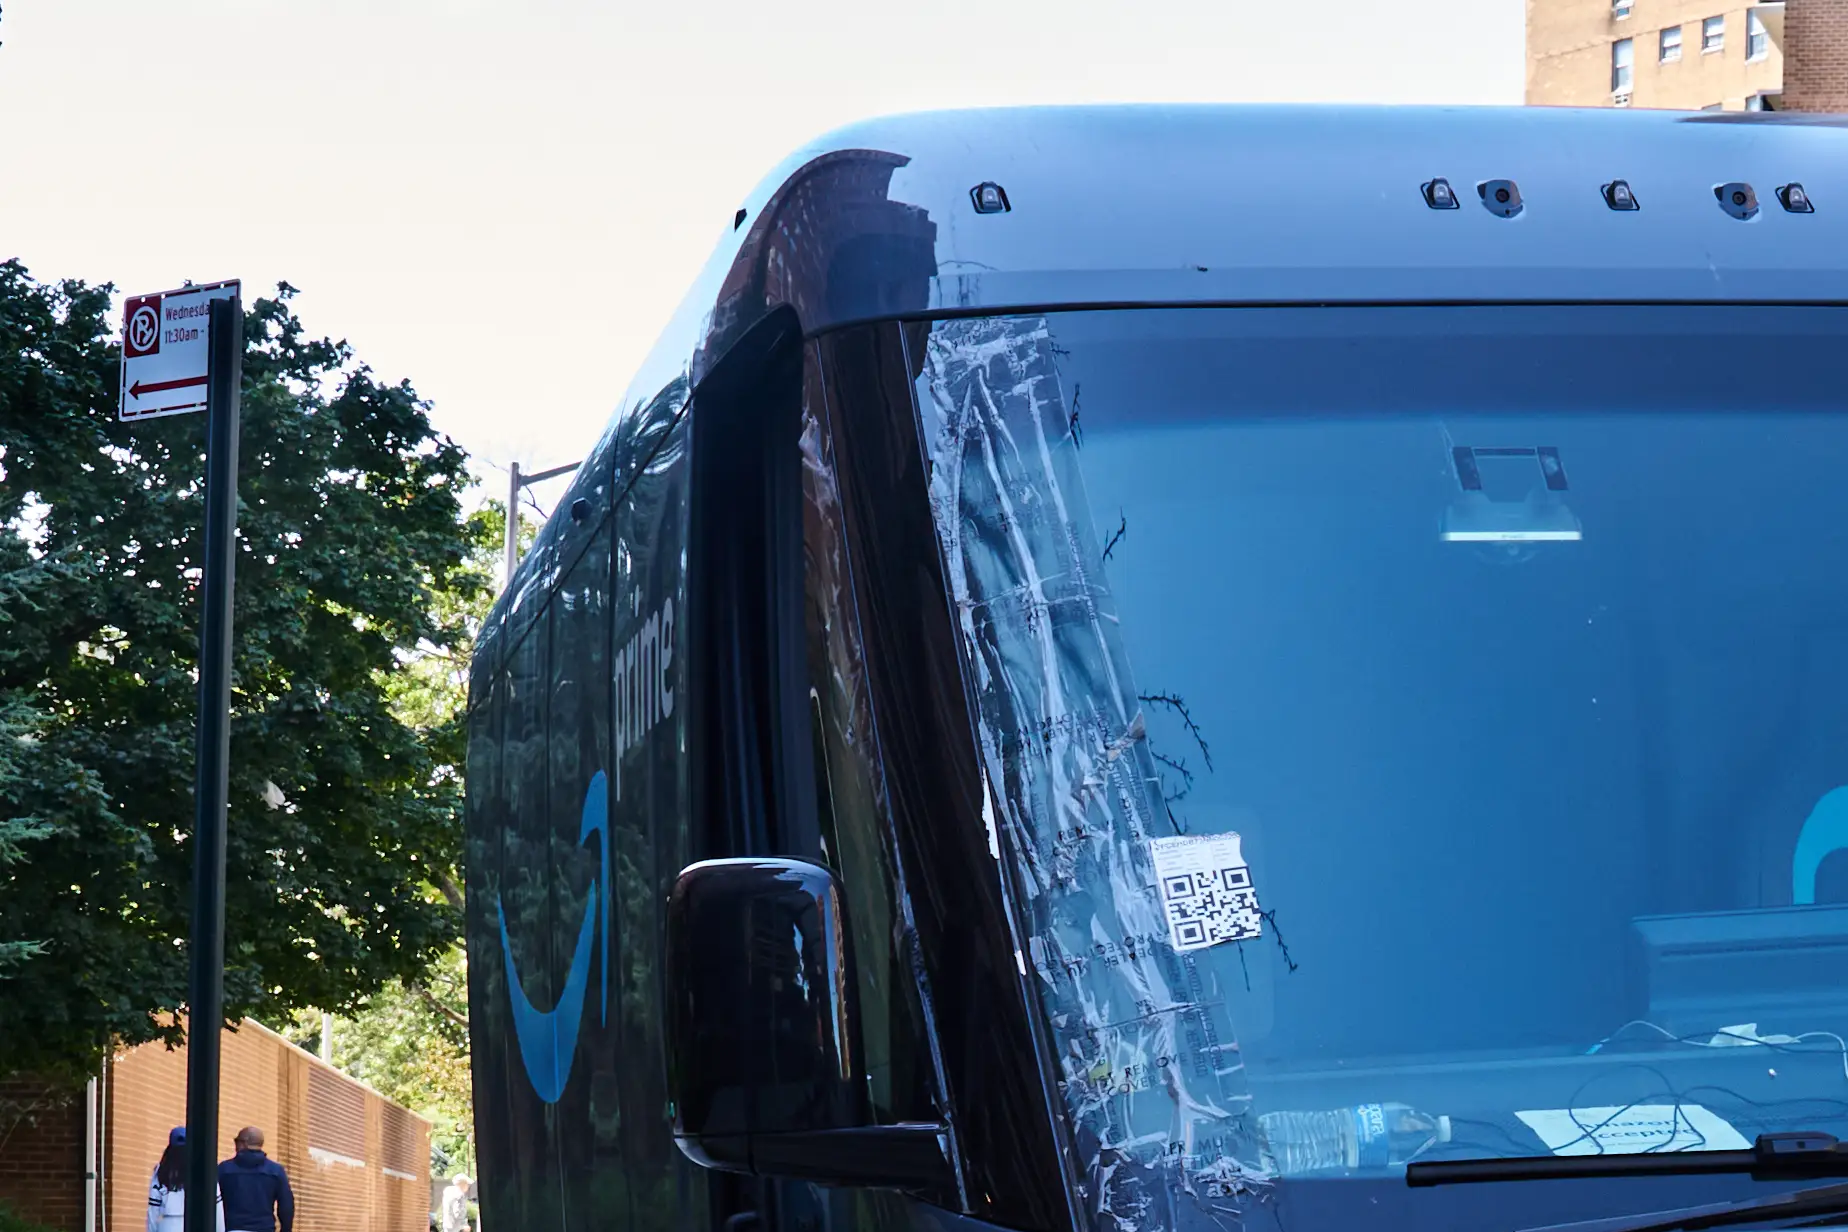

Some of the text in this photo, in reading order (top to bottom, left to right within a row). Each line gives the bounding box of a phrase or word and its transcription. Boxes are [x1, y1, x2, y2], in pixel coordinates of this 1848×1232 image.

[165, 304, 210, 321] Wednesda
[164, 328, 198, 344] 11:30am
[613, 584, 674, 801] prime
[1108, 1075, 1157, 1096] COVER
